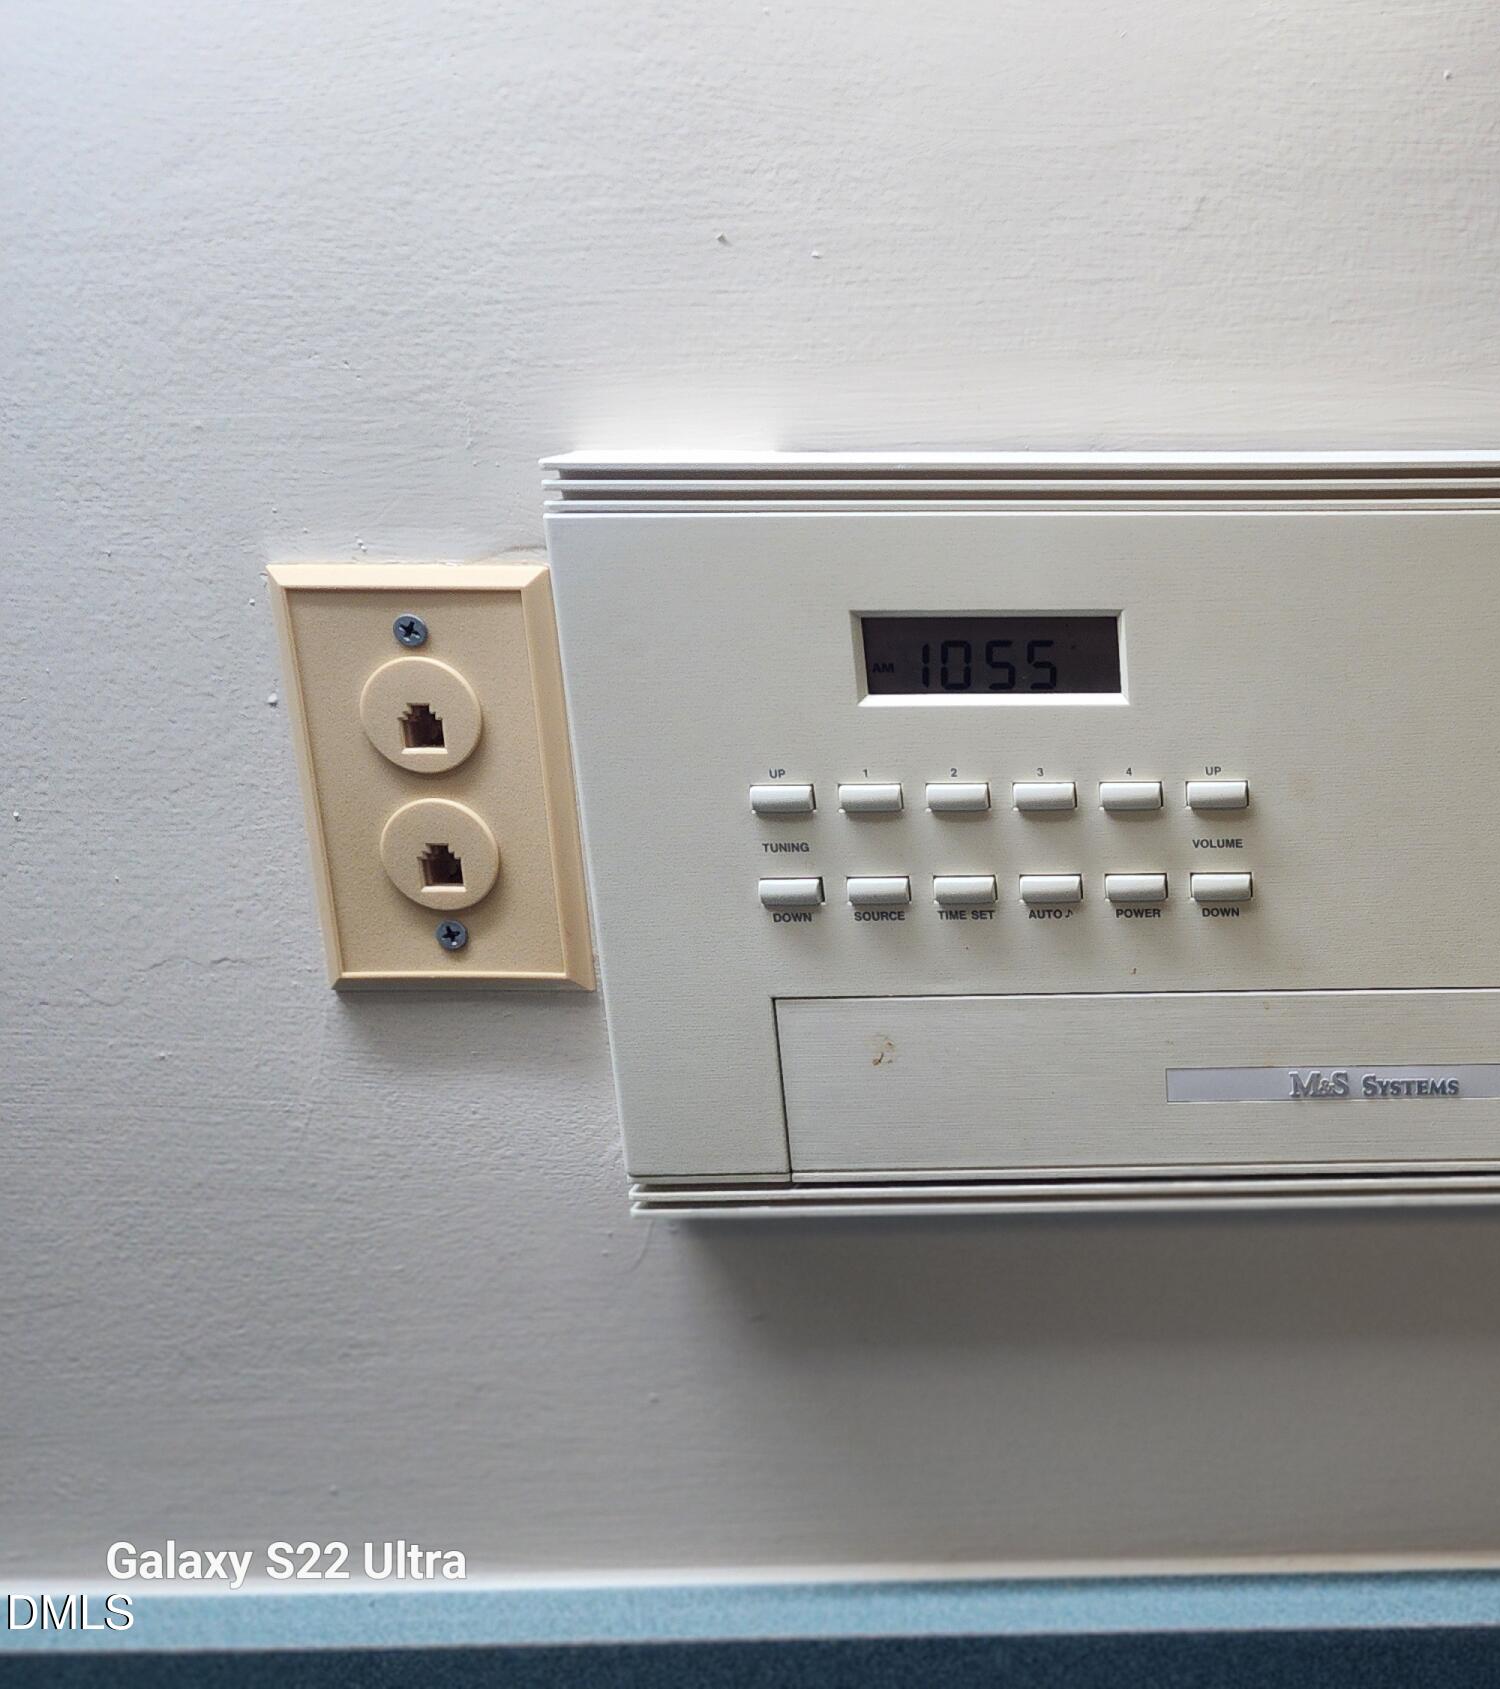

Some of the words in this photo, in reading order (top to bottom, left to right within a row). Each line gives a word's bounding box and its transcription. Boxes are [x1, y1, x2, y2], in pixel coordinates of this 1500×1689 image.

[872, 663, 895, 673] AM
[921, 640, 1057, 690] 1055
[769, 768, 786, 779] UP
[950, 768, 958, 777] 2
[1036, 767, 1044, 777] 3
[1126, 767, 1132, 776] 4
[1205, 766, 1221, 776] UP
[762, 842, 810, 853] TUNING
[1192, 838, 1243, 849] VOLUME
[773, 912, 812, 923] DOWN
[854, 911, 905, 922] SOURCE
[938, 910, 966, 921] TIME
[971, 909, 995, 920] SET
[1115, 908, 1161, 919] POWER
[1202, 907, 1240, 918] DOWN
[1288, 1070, 1350, 1098] M&S
